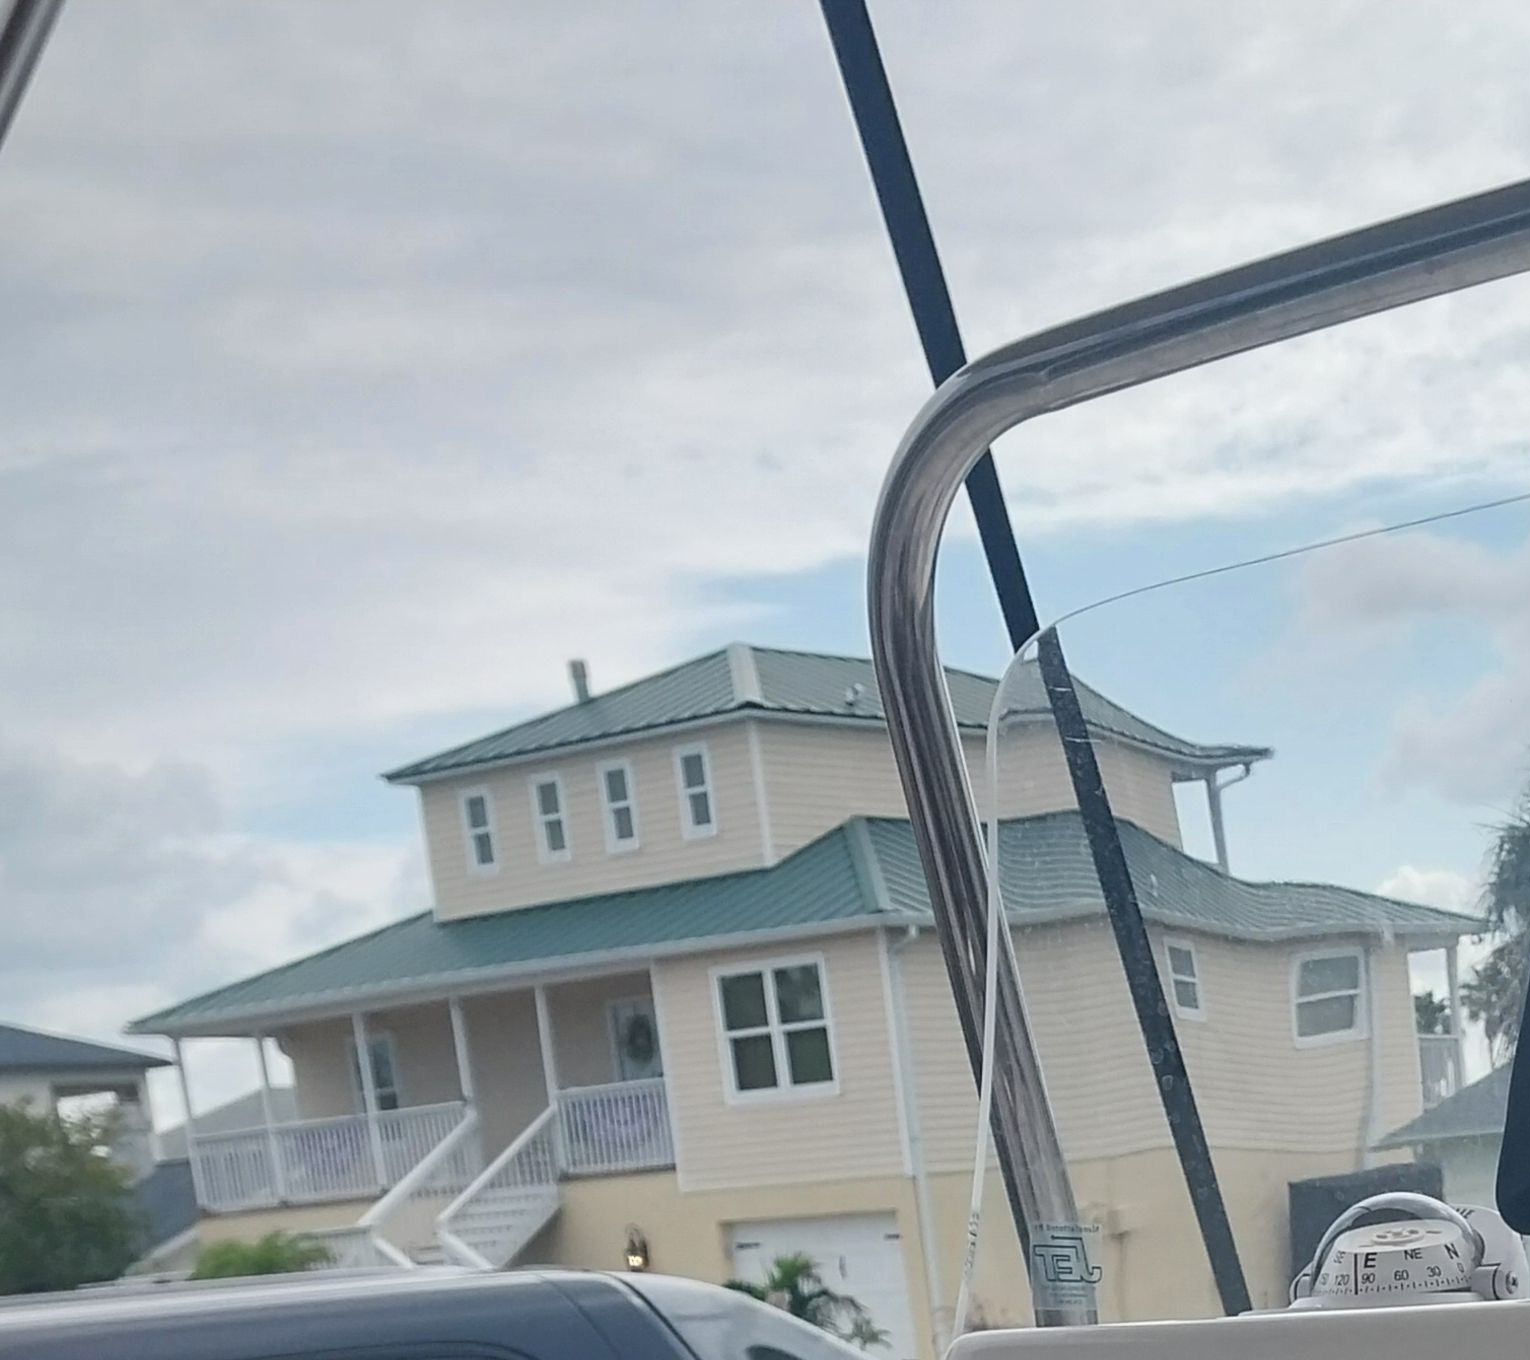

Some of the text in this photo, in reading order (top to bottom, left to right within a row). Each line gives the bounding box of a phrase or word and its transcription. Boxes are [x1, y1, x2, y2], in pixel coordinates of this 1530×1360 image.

[1364, 1252, 1377, 1268] E
[1404, 1248, 1423, 1260] NE
[1444, 1243, 1460, 1259] N
[1334, 1274, 1349, 1286] 120
[1361, 1273, 1375, 1284] 90
[1394, 1270, 1409, 1281] 60
[1426, 1266, 1441, 1278] 30
